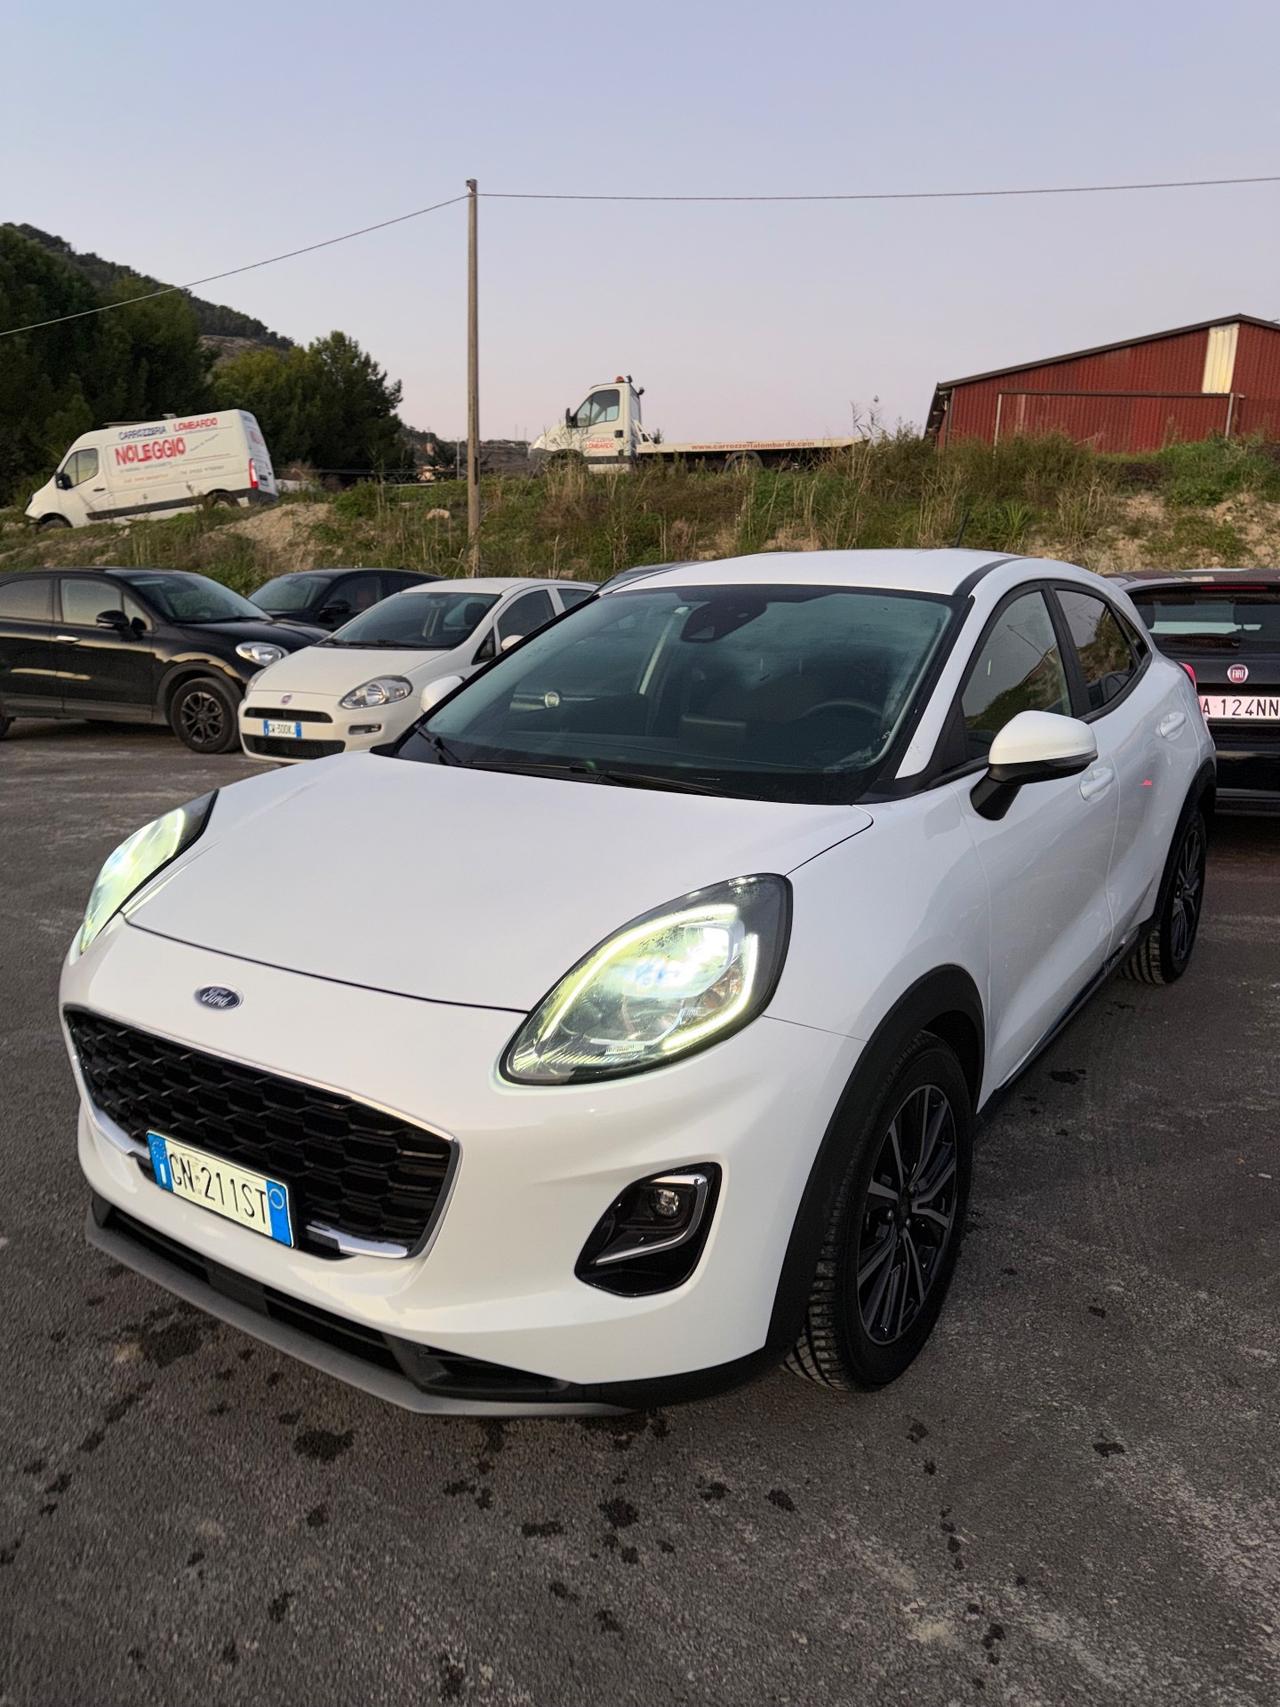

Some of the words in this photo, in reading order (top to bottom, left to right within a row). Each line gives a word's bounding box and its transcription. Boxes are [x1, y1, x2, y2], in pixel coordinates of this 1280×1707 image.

[173, 417, 218, 433] LOMBARDO
[114, 437, 186, 466] NOLEGGIO
[1202, 698, 1211, 715] A
[1221, 698, 1279, 717] 124NN
[201, 987, 233, 1008] Ford
